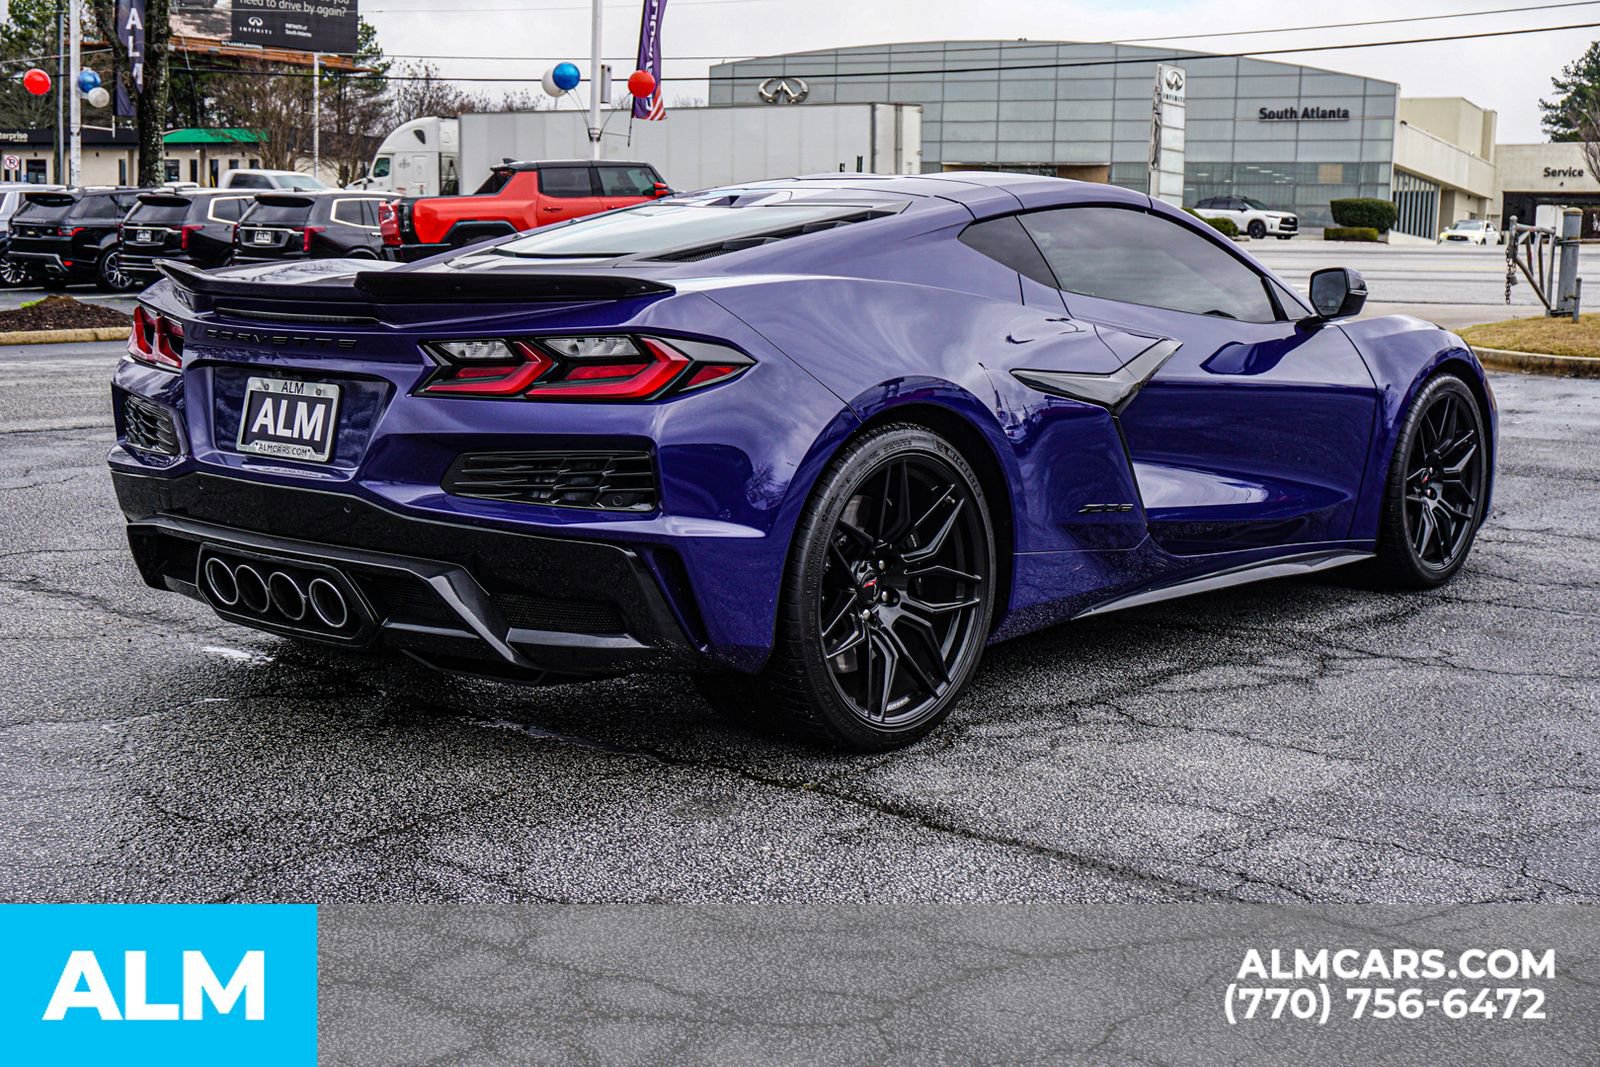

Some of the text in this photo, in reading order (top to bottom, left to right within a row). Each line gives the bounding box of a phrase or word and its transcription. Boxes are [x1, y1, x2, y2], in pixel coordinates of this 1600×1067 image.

[266, 0, 277, 8] to
[278, 0, 302, 12] drive
[303, 2, 315, 15] by
[316, 6, 347, 18] again?
[239, 27, 272, 35] INFINITI
[1259, 106, 1350, 120] South Atlanta
[1543, 166, 1584, 178] Service
[207, 329, 357, 348] CORVETTE
[281, 381, 305, 395] ALM
[251, 397, 326, 442] ALM
